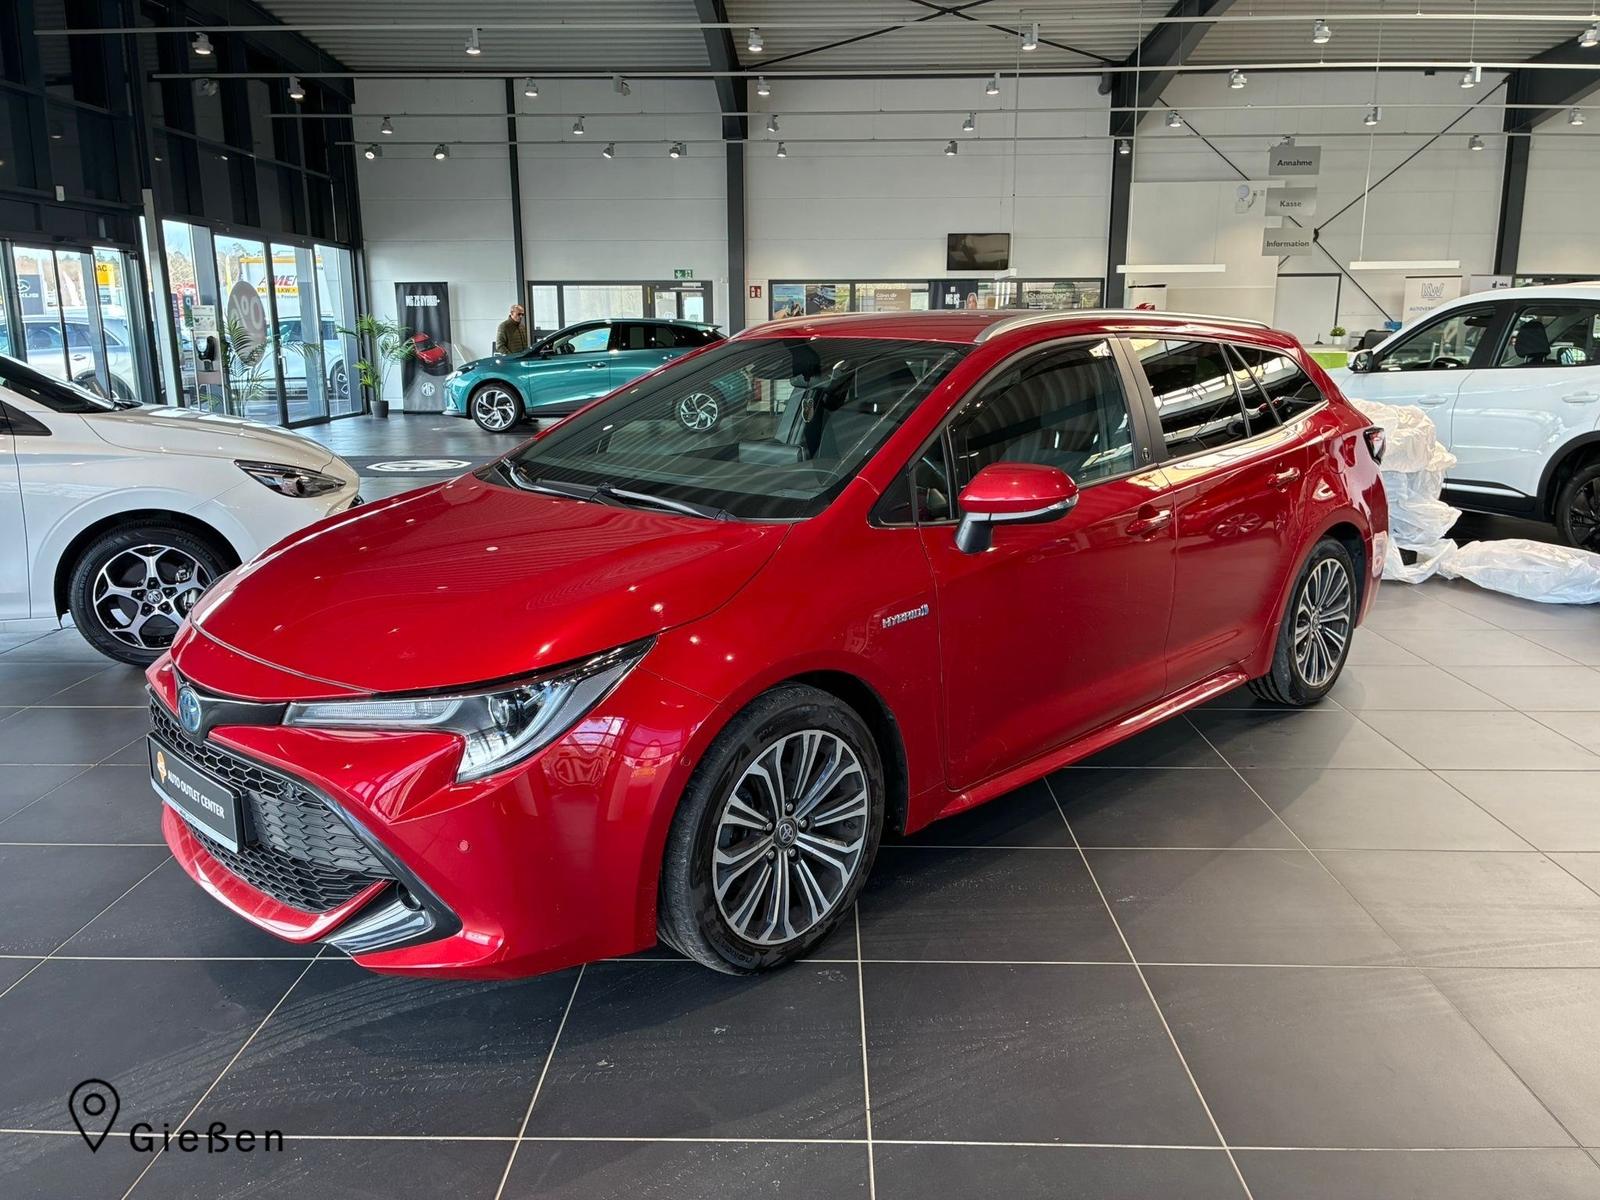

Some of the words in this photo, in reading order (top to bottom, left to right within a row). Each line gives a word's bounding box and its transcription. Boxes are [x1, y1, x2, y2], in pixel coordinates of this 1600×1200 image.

[1279, 200, 1302, 208] Kasse
[1265, 240, 1310, 248] Information
[882, 606, 924, 629] HYBRID
[167, 769, 181, 789] AUTO
[180, 780, 201, 804] OUTLET
[200, 794, 225, 819] CENTER
